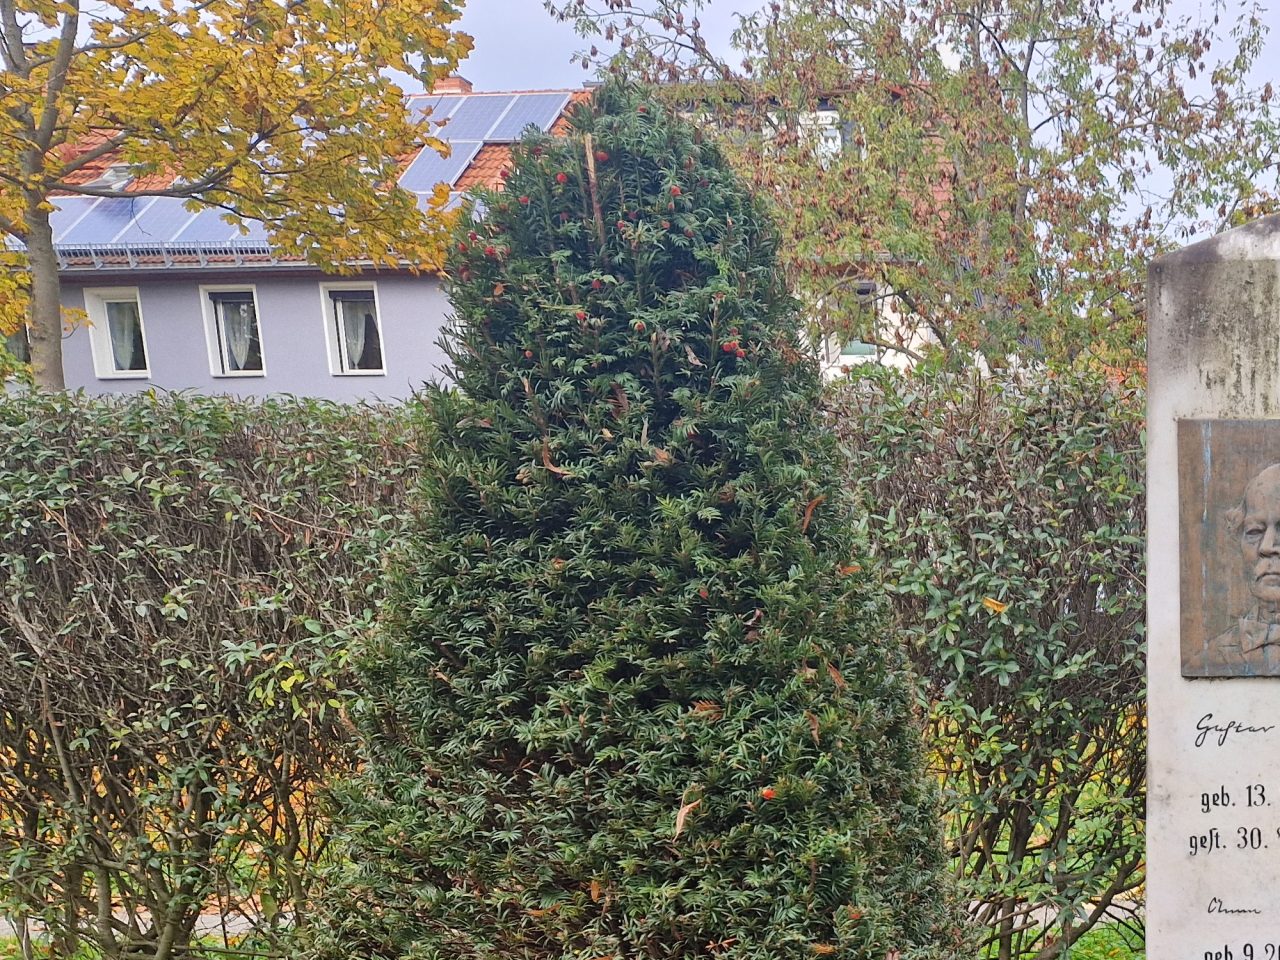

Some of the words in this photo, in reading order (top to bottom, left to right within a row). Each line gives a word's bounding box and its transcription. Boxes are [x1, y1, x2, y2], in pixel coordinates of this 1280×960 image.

[1200, 784, 1236, 814] geb.
[1245, 783, 1272, 808] 13.
[1236, 826, 1269, 850] 30.
